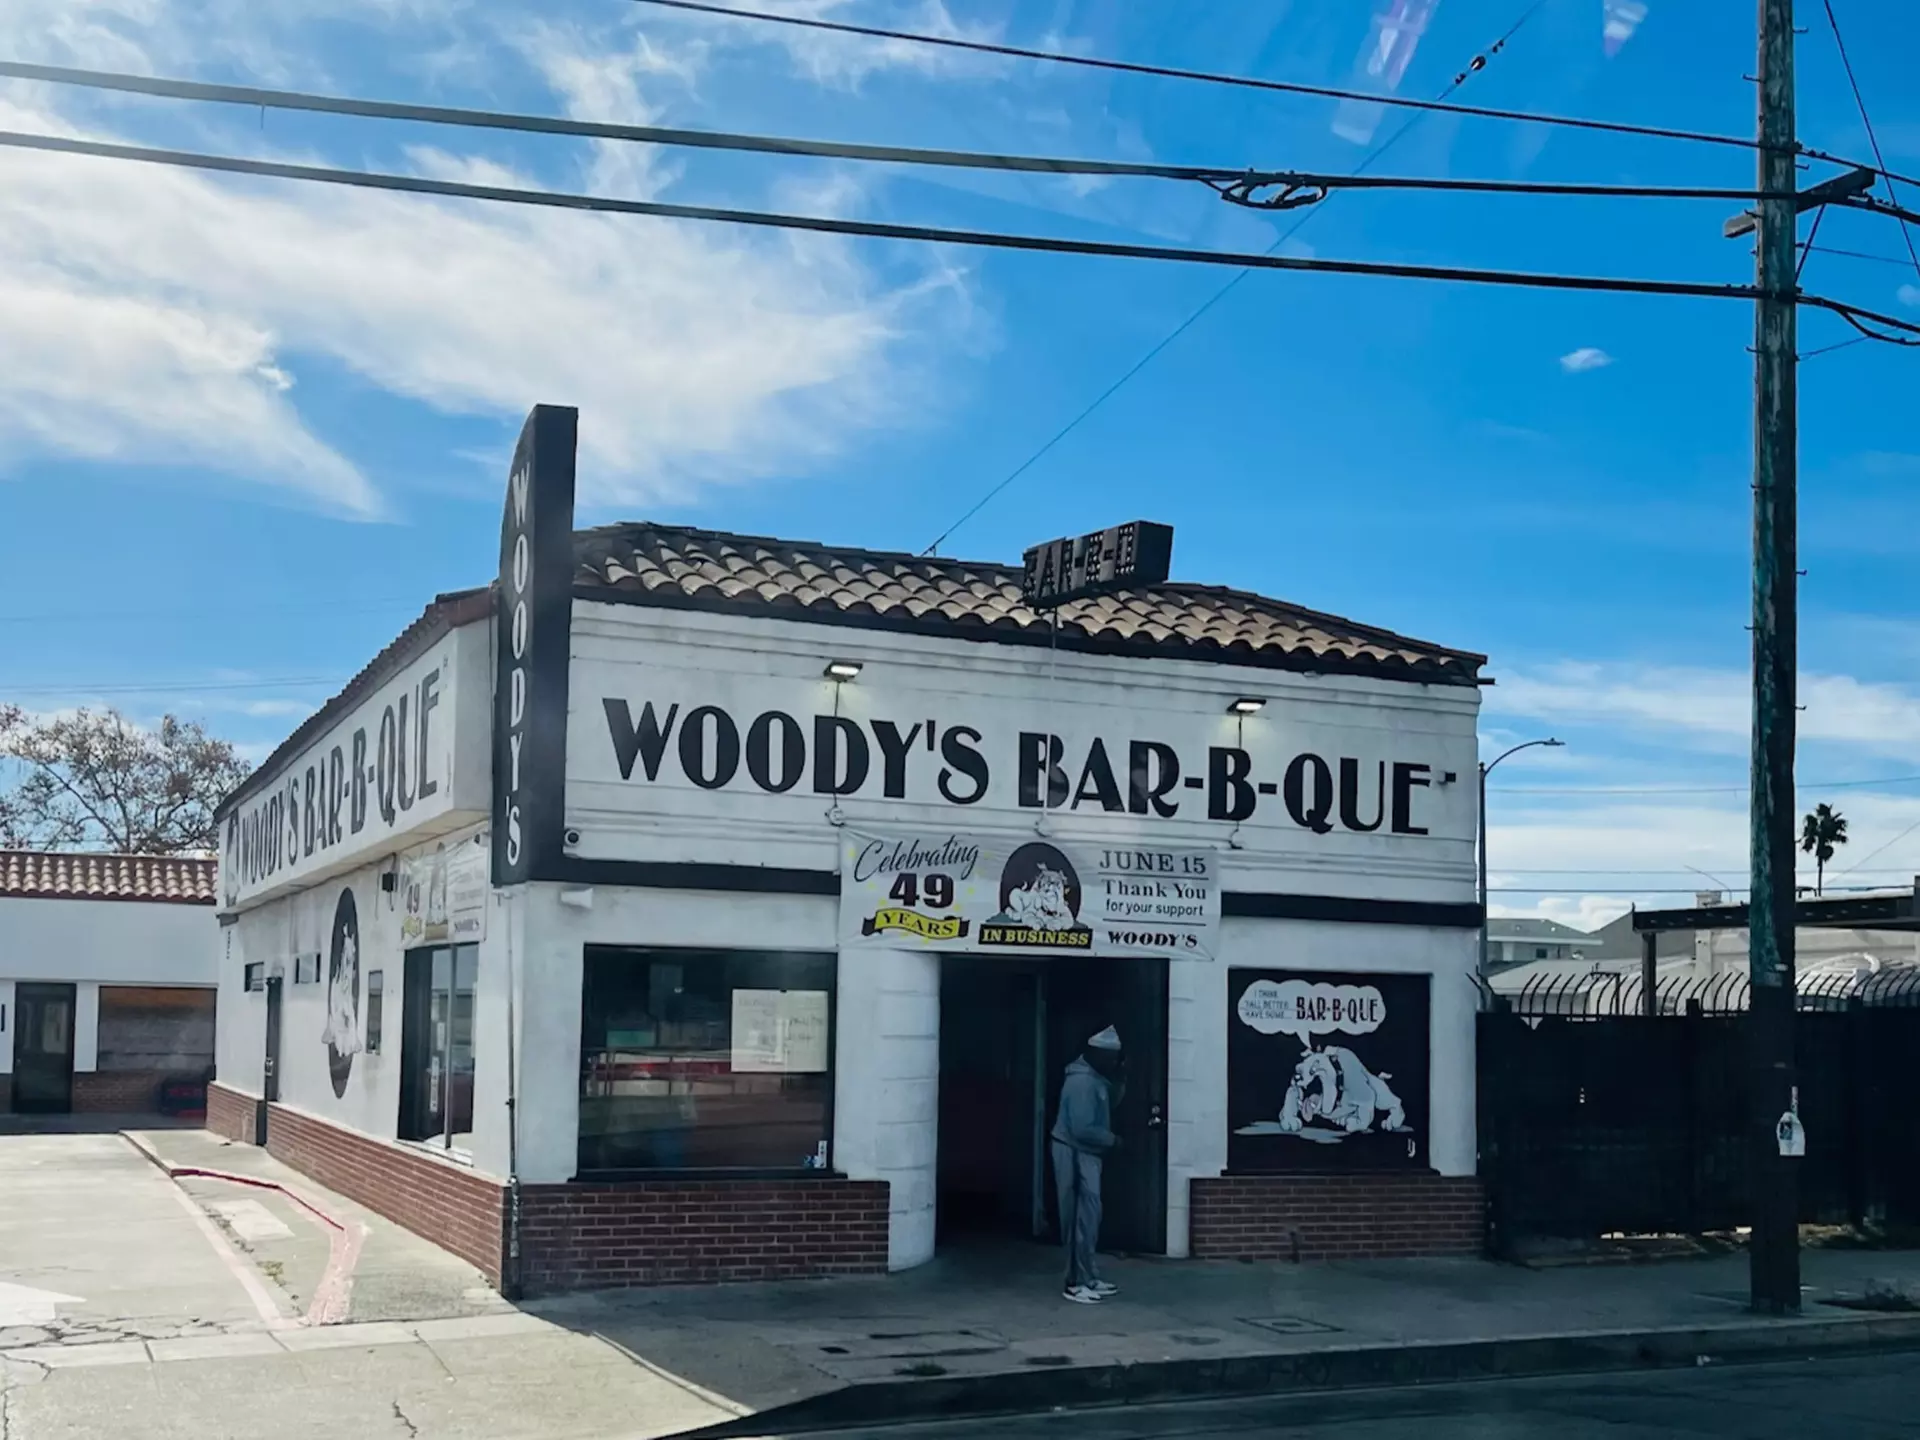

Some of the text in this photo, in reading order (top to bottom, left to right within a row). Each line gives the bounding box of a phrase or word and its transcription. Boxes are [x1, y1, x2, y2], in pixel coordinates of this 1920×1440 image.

[505, 461, 530, 867] WOODY'S
[242, 668, 440, 885] WOODY'S BAR-B-QUE
[602, 697, 1431, 835] WOODY'S BAR-B-QUE
[853, 834, 980, 883] Celebrating
[1099, 849, 1207, 875] JUNE 15
[888, 872, 955, 909] 49
[1101, 878, 1207, 900] Thank You
[1105, 898, 1204, 918] for your support
[882, 911, 955, 937] YEARS
[982, 928, 1090, 946] IN BUSINESS
[1107, 930, 1199, 949] WOODY'S
